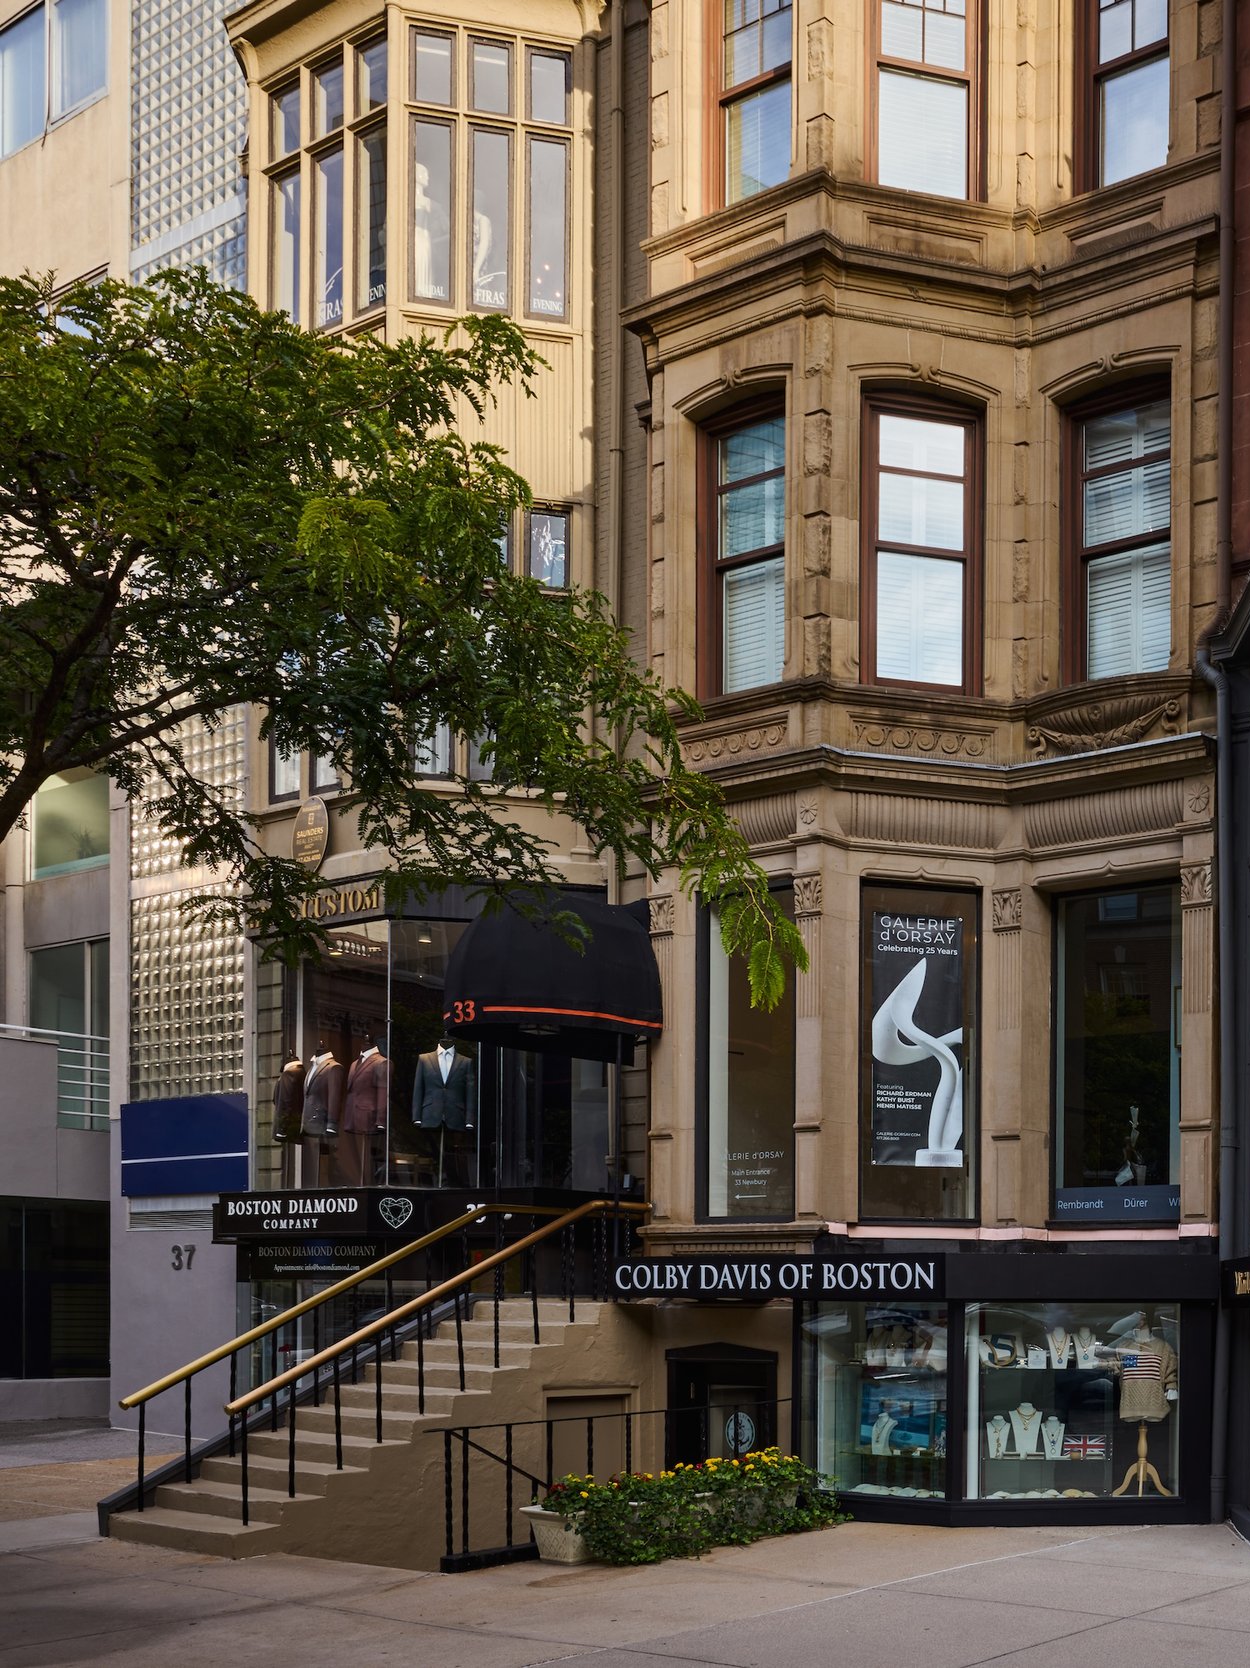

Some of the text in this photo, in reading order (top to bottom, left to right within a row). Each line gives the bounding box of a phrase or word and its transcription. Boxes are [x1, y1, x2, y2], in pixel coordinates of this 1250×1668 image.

[476, 289, 505, 305] FIRAS
[533, 298, 563, 313] EVENING
[297, 827, 324, 839] SAUNDERS
[302, 889, 379, 919] CUSTOM
[880, 916, 955, 932] GALERIE
[880, 929, 955, 944] d'ORSAY
[878, 944, 924, 955] Celebrating
[937, 948, 958, 956] Years
[453, 1000, 475, 1023] 33
[752, 1151, 784, 1160] d'ORSAY
[228, 1198, 358, 1216] BOSTON DIAMOND
[1058, 1200, 1104, 1210] Rembrandt
[1124, 1198, 1148, 1208] Dürer
[263, 1219, 318, 1229] COMPANY
[172, 1245, 196, 1271] 37
[259, 1246, 376, 1257] BOSTON DIAMOND COMPANY
[615, 1262, 935, 1290] COLBY DAVIS OF BOSTON
